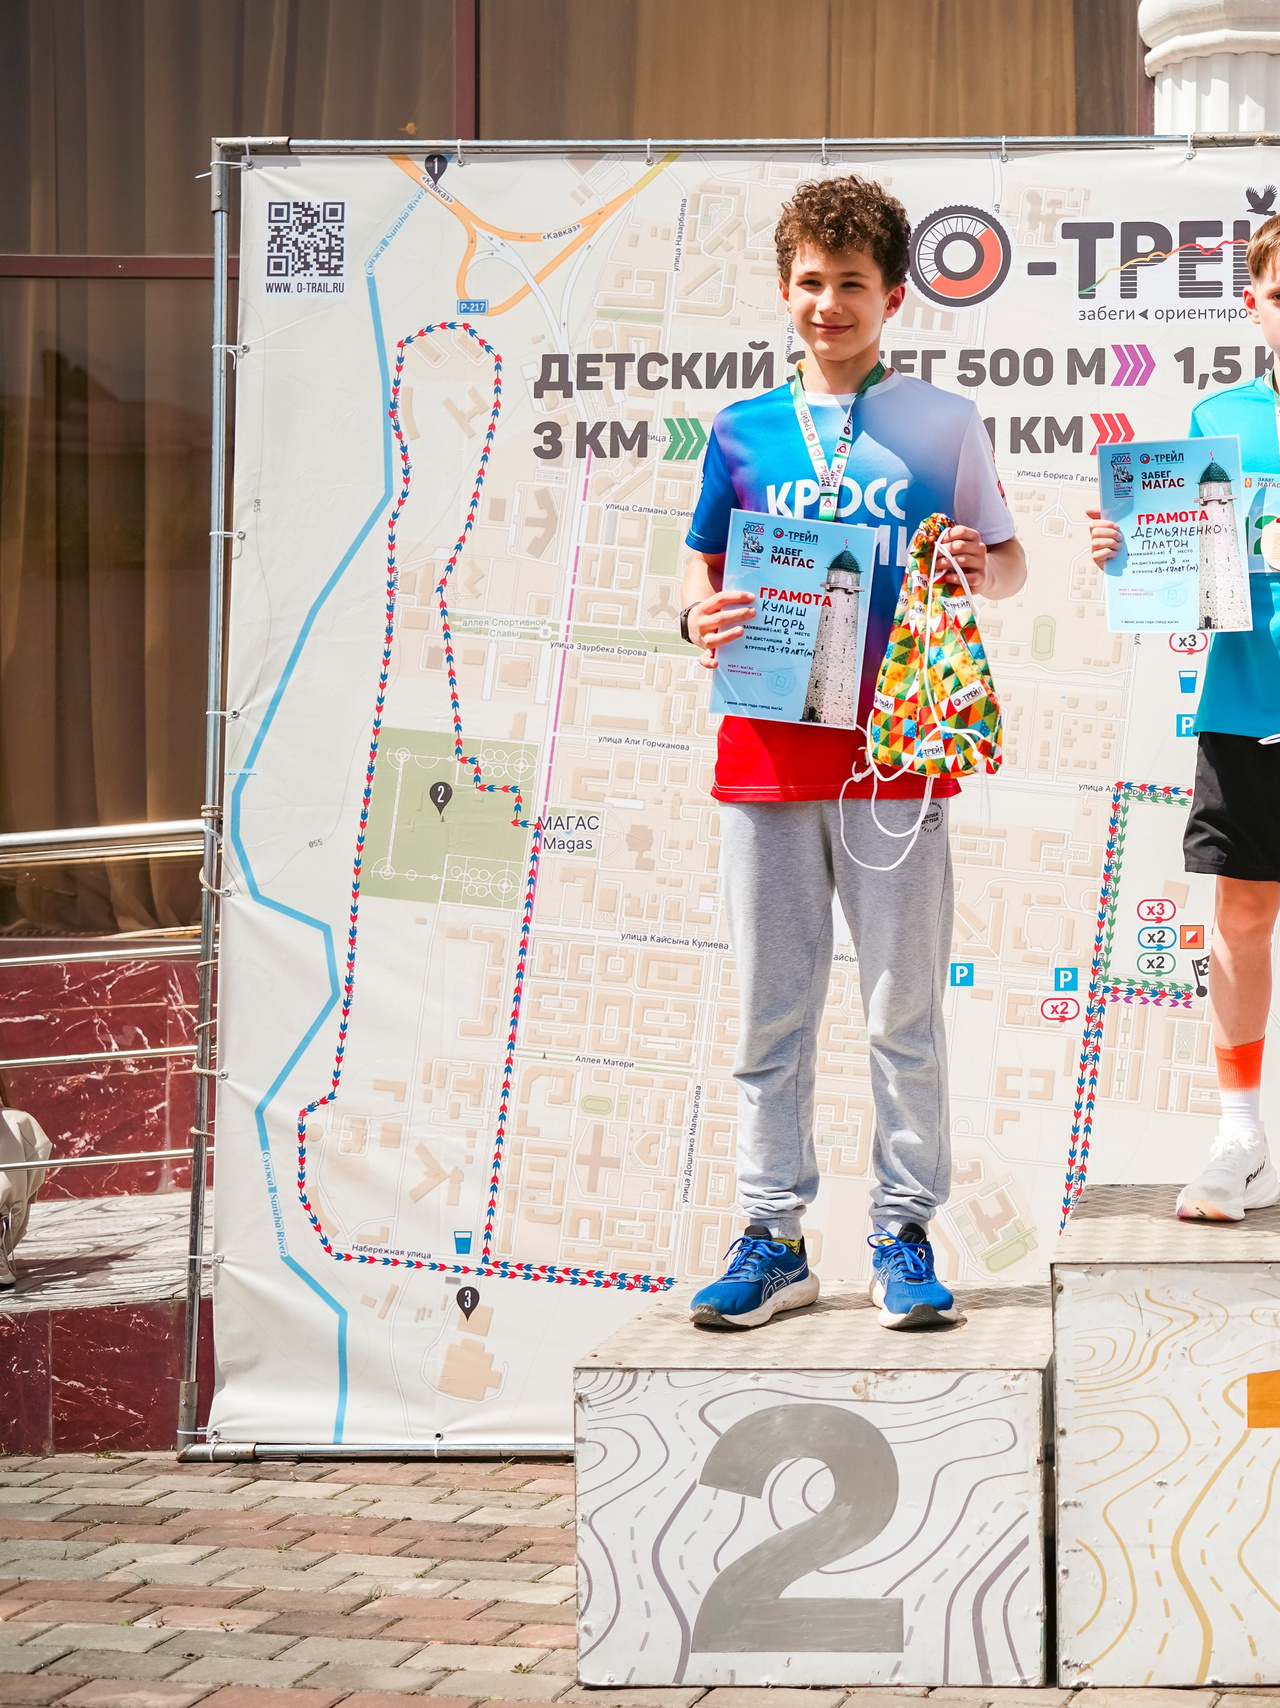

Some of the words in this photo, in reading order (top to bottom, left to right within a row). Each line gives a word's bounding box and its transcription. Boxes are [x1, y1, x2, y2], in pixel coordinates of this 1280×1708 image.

[433, 158, 439, 174] 1
[677, 198, 688, 246] Назарбаева
[673, 247, 682, 271] улица
[265, 282, 293, 293] WWW.
[1078, 304, 1136, 321] забеги
[1154, 304, 1250, 323] ориентиро
[534, 340, 774, 399] ДЕТСКИЙ
[957, 347, 1053, 387] 500
[1067, 347, 1106, 386] М
[1174, 346, 1242, 390] 1,5
[533, 421, 564, 459] 3
[575, 421, 649, 459] КМ
[1010, 415, 1084, 454] КМ
[1016, 469, 1041, 478] улица
[1043, 471, 1073, 481] Бориса
[1075, 474, 1099, 483] Гагие
[1141, 470, 1171, 479] ЗАБЕГ
[1142, 478, 1185, 490] МАГАС
[766, 477, 908, 520] КРОСС
[605, 502, 626, 512] улица
[628, 504, 668, 515] Салмана
[1137, 510, 1209, 526] ГРАМОТА
[772, 546, 803, 556] ЗАБЕГ
[1142, 540, 1189, 551] ПЛАТОН
[770, 554, 815, 569] МАГАС
[760, 587, 832, 608] ГРАМОТА
[761, 600, 807, 617] КУЛИШ
[491, 617, 547, 629] Спортивной
[764, 615, 805, 631] ИГОРЬ
[490, 629, 519, 639] Славы
[550, 640, 575, 650] улица
[576, 642, 615, 654] Заурбека
[617, 646, 648, 657] Борова
[598, 736, 622, 746] улица
[624, 736, 638, 746] Али
[640, 739, 690, 751] Горчханова
[438, 785, 445, 803] 2
[1078, 784, 1103, 794] улица
[538, 816, 600, 831] МАГАС
[543, 837, 593, 852] Magas
[620, 932, 648, 943] улица
[650, 934, 690, 946] Кайсына
[691, 939, 730, 950] Кулиева
[574, 1055, 601, 1066] Аллея
[602, 1057, 635, 1069] Матери
[689, 1085, 702, 1138] Мальсагова
[684, 1139, 695, 1179] Дошлако
[681, 1180, 690, 1204] улица
[269, 1193, 284, 1232] Sunzha
[276, 1231, 289, 1258] River
[351, 1244, 403, 1259] Набережная
[405, 1249, 432, 1259] улица
[464, 1290, 472, 1308] 3
[692, 1404, 903, 1655] 2
